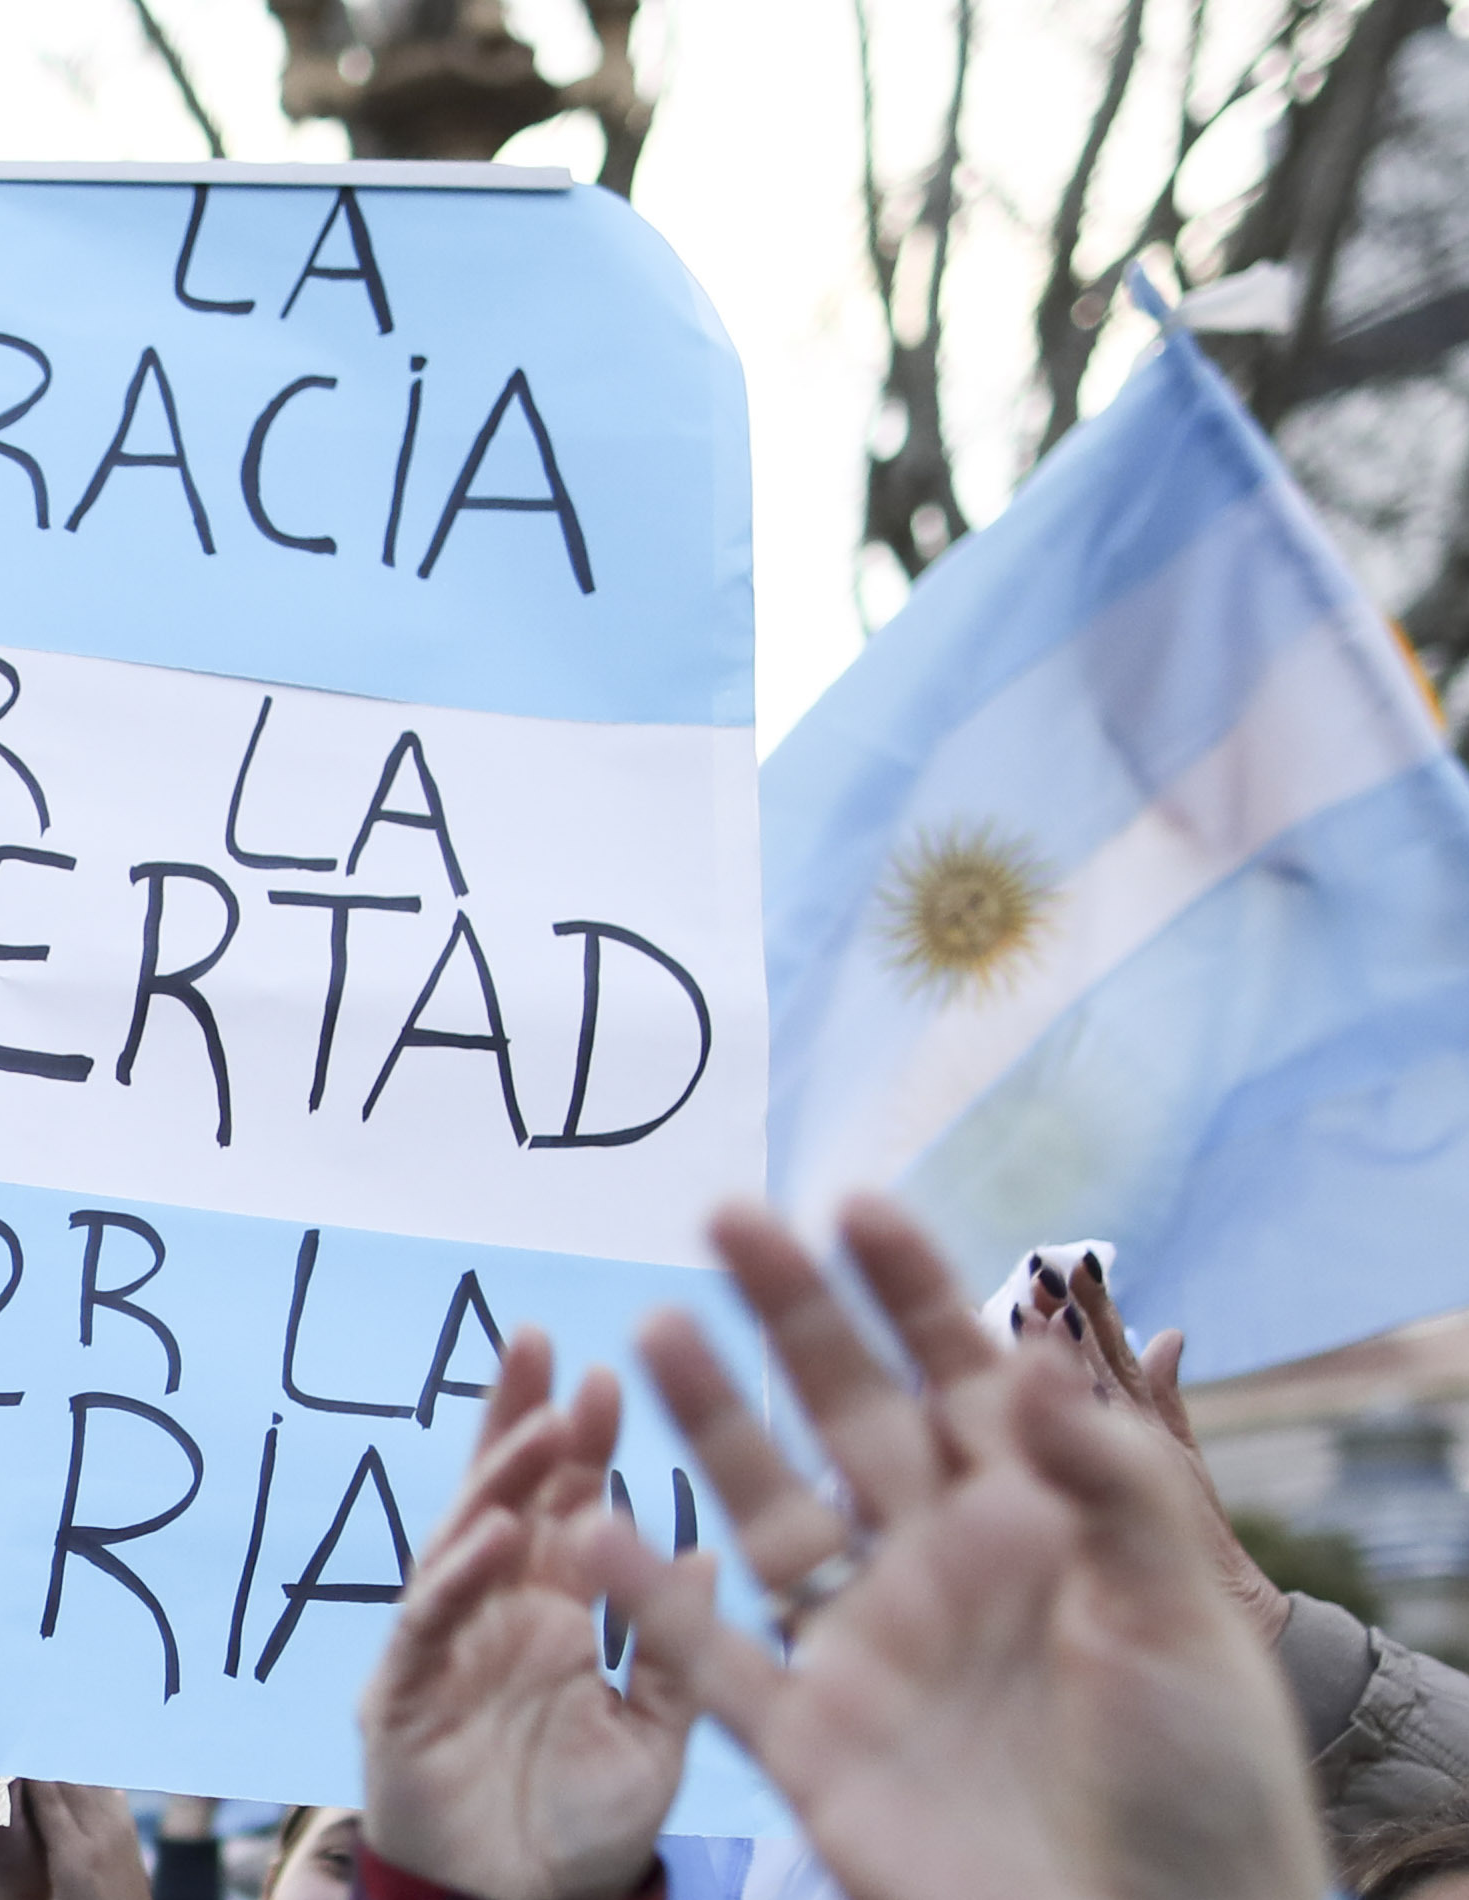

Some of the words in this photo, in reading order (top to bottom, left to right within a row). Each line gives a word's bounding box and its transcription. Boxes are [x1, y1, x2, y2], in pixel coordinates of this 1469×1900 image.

[173, 182, 396, 335] LA
[227, 697, 469, 896] LA
[285, 1229, 506, 1428] LA
